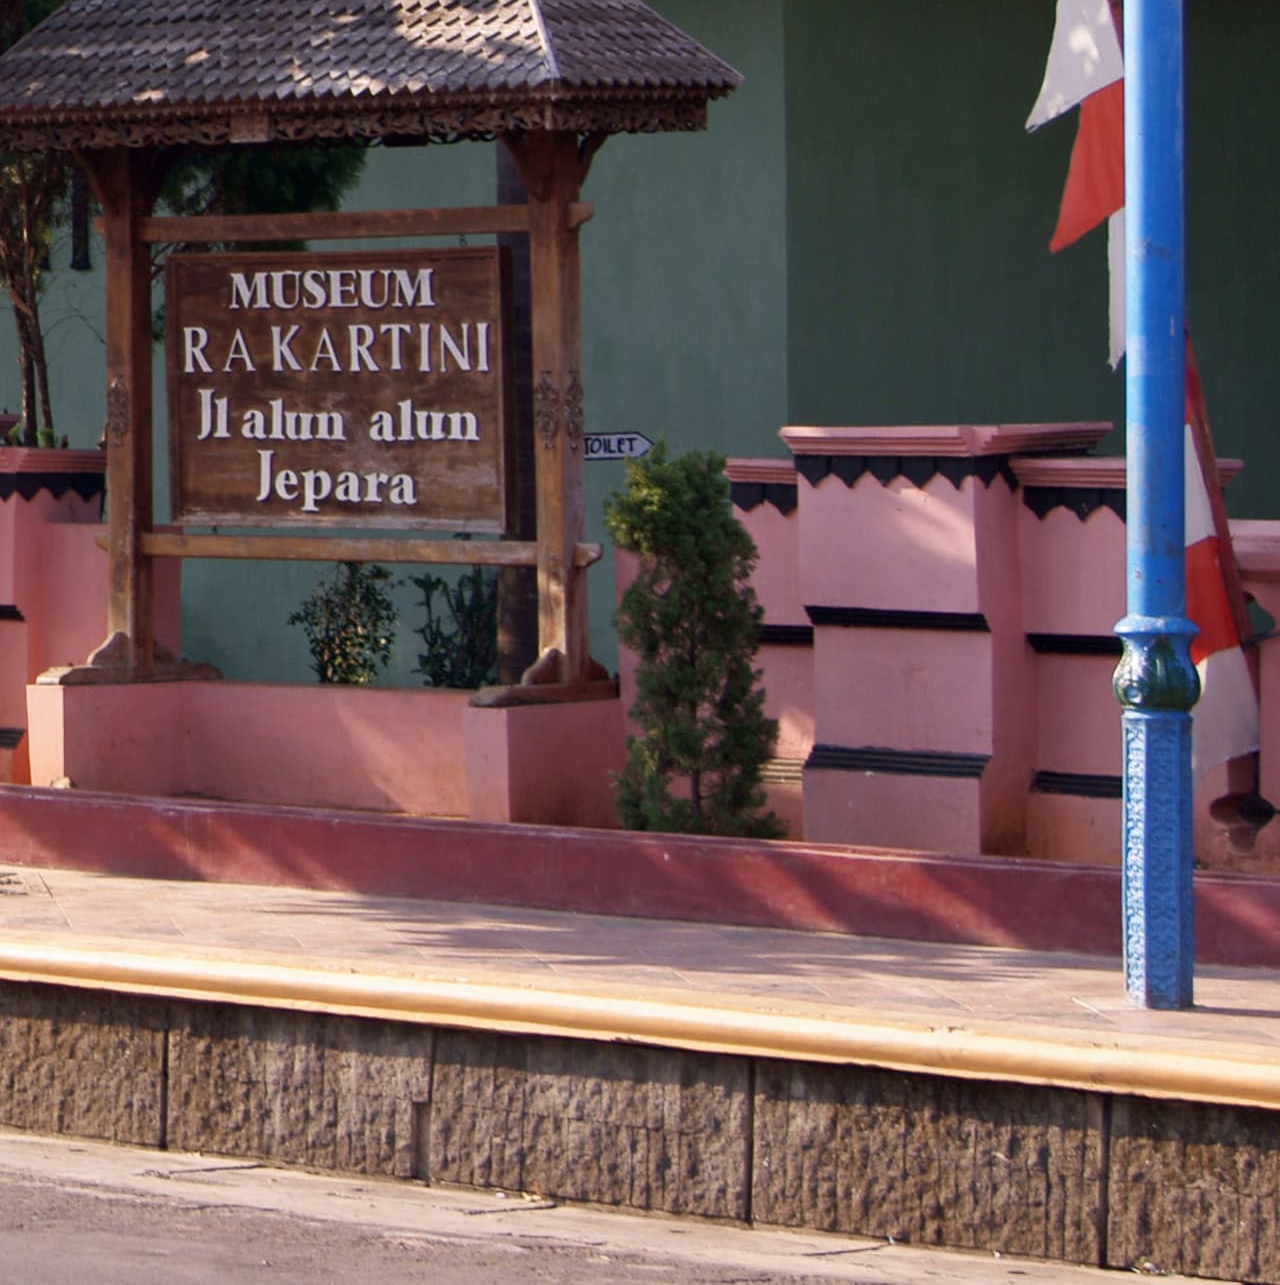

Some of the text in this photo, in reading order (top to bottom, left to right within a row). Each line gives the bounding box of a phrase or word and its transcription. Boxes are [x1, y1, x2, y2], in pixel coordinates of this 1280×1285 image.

[229, 267, 436, 311] MUSEUM
[270, 321, 491, 374] KARTINI
[197, 388, 481, 442] Jl alun alun
[584, 436, 639, 455] TOILET
[256, 450, 418, 513] Jepara
